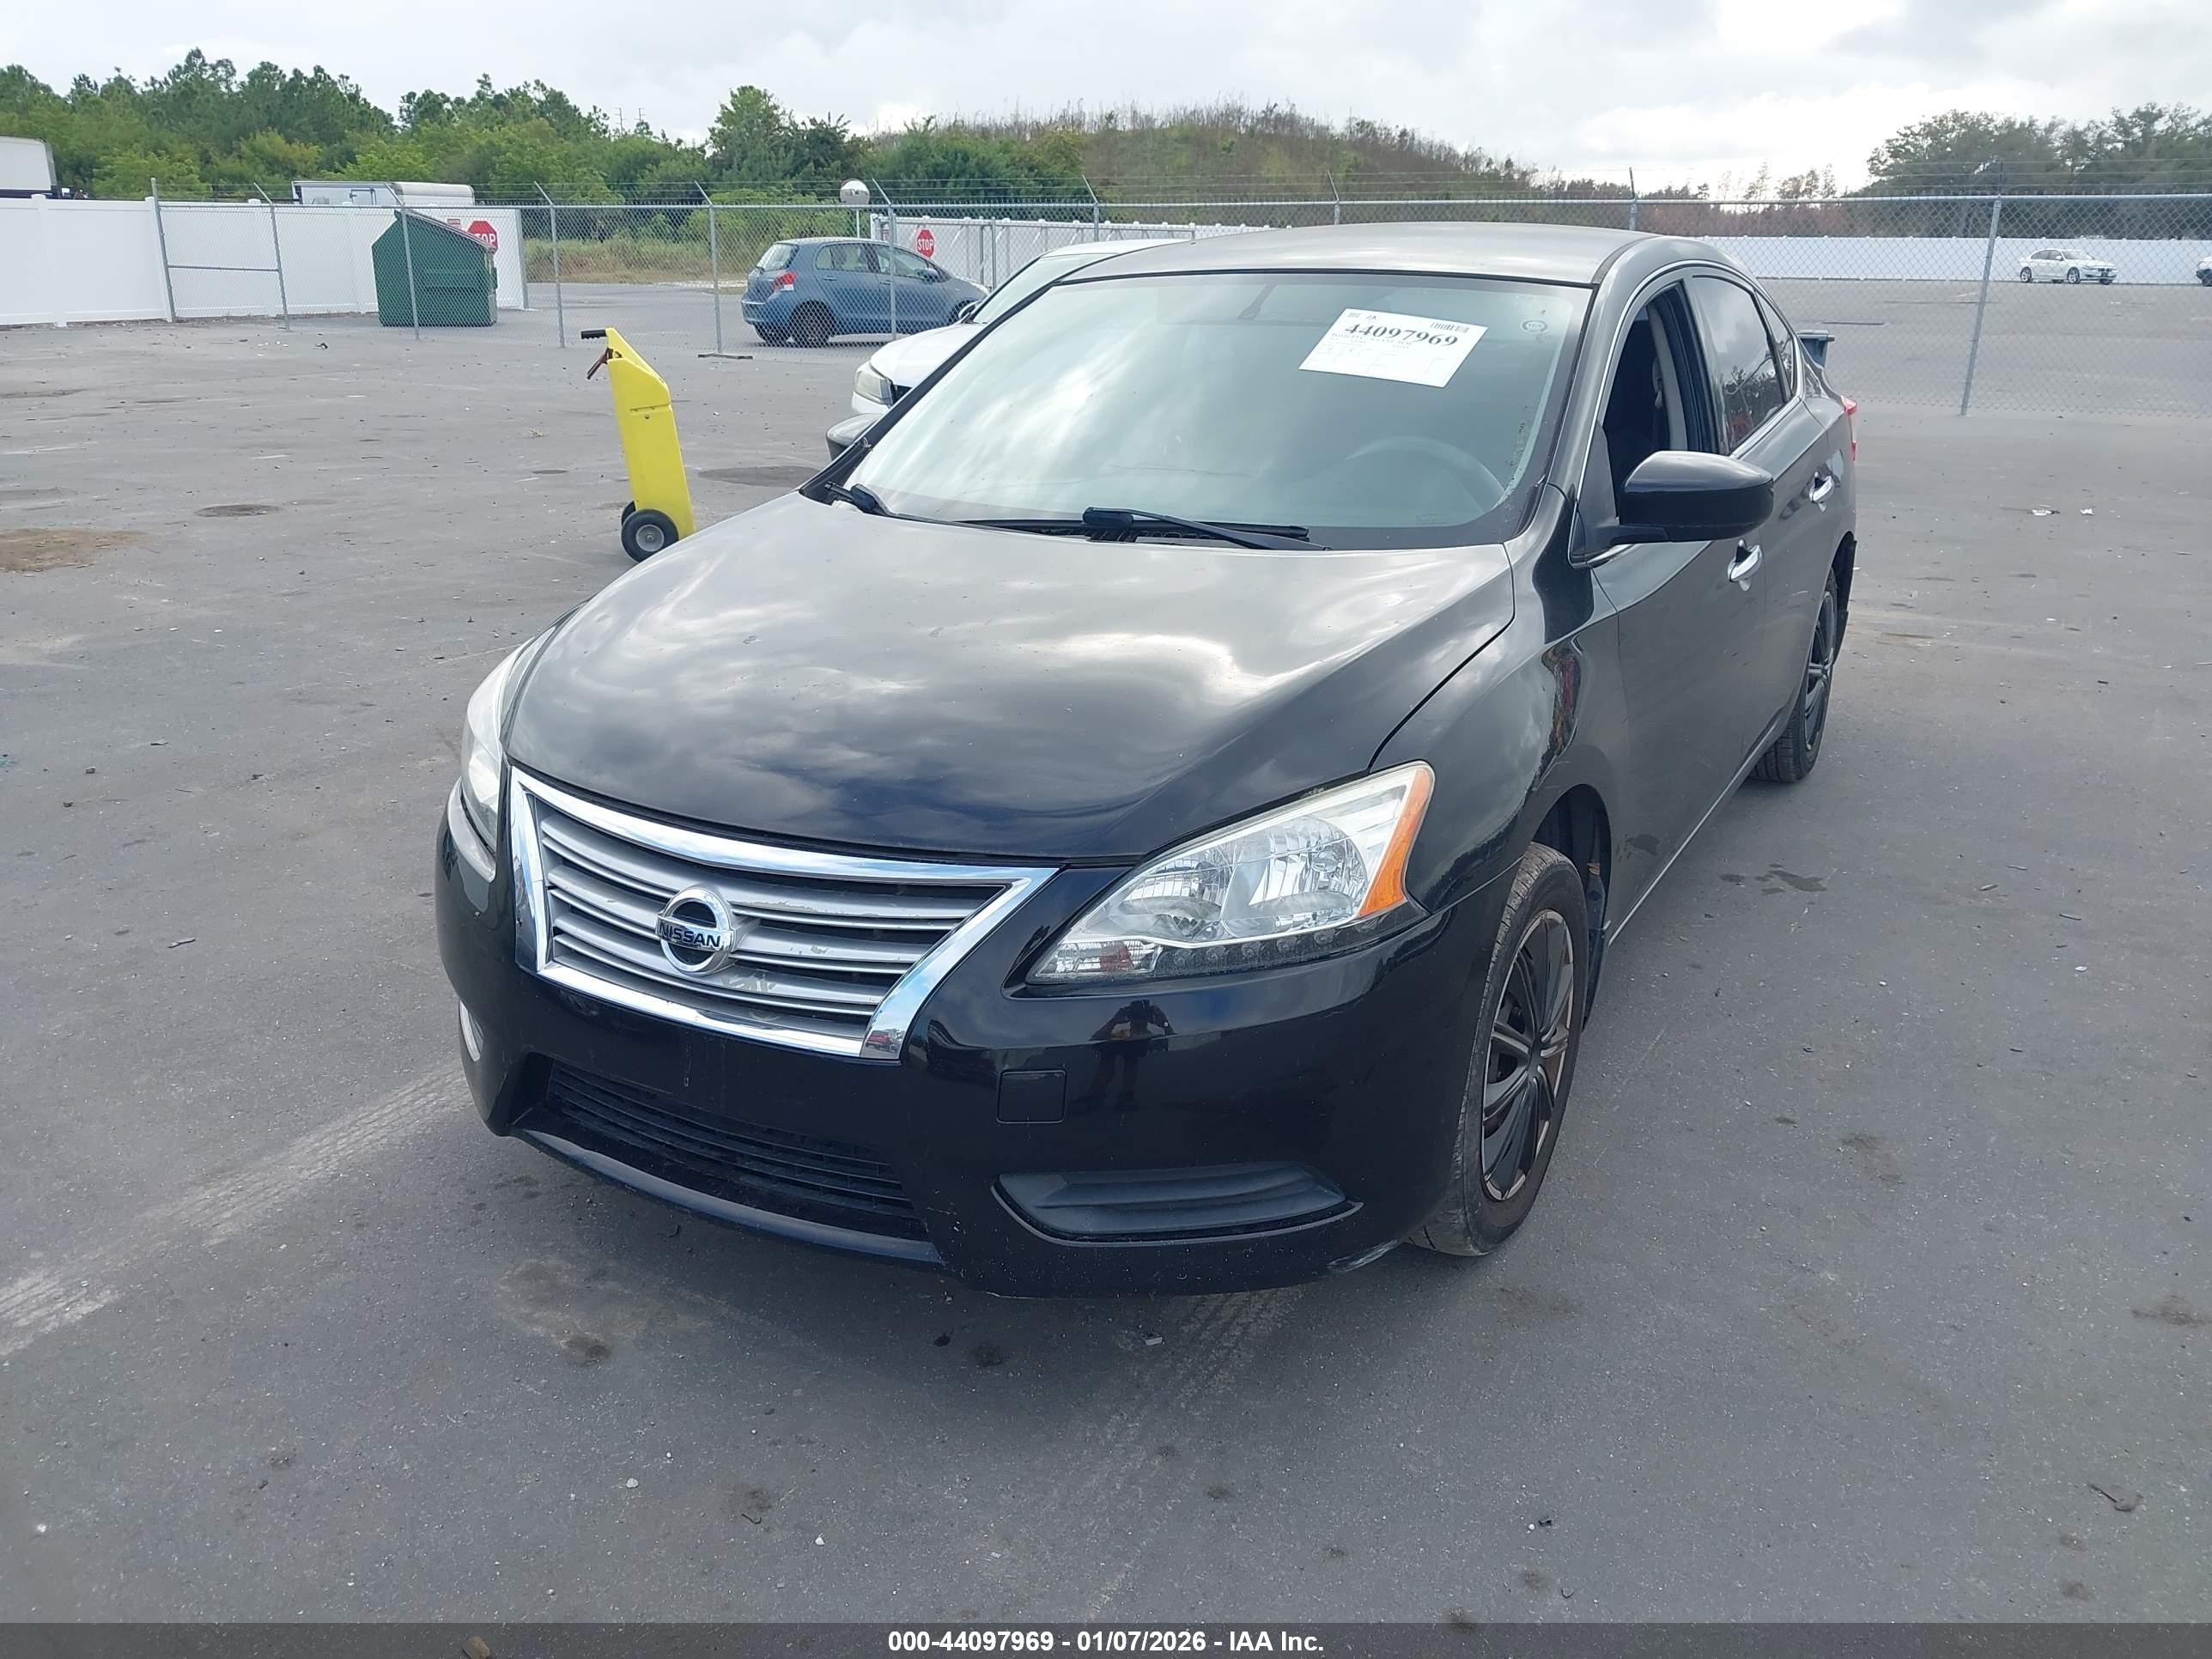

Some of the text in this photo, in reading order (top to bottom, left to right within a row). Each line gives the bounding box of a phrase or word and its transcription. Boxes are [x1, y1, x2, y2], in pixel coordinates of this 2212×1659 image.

[917, 239, 933, 251] STOP
[1344, 323, 1459, 347] 44097969
[659, 922, 721, 948] NISSAN
